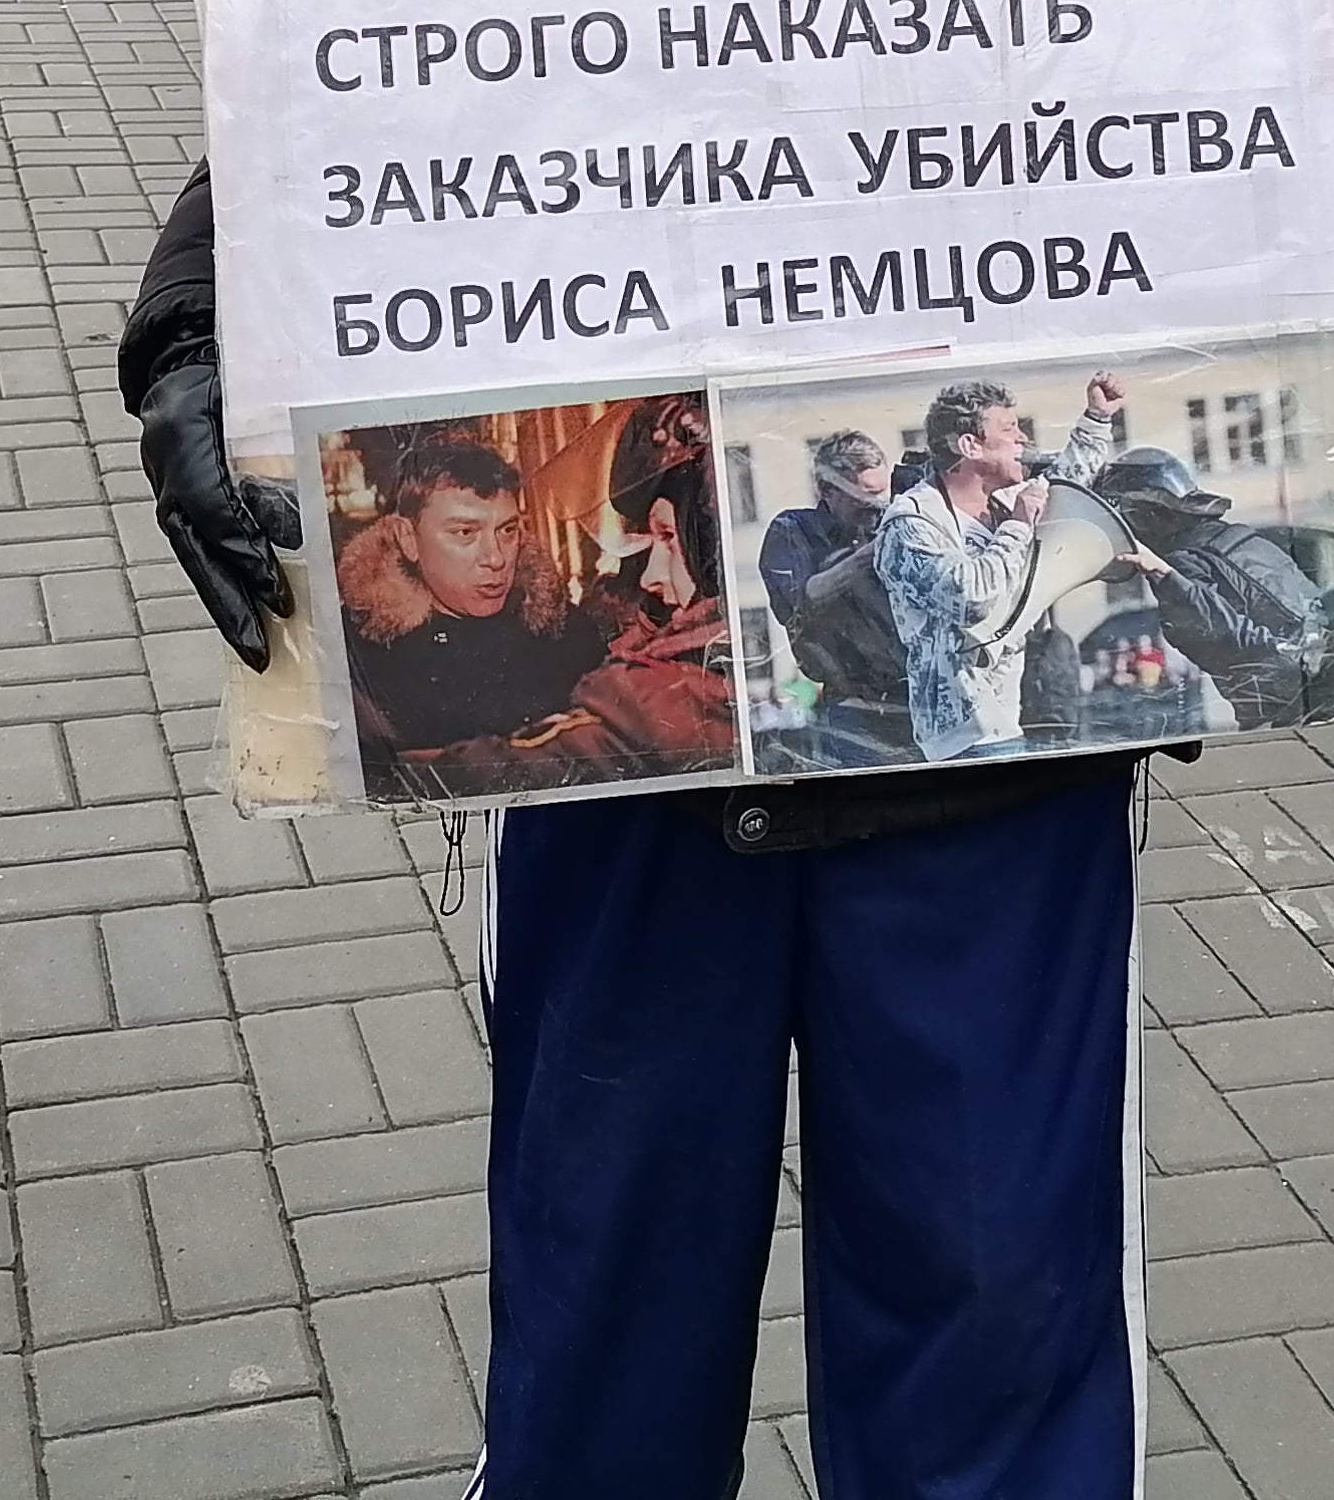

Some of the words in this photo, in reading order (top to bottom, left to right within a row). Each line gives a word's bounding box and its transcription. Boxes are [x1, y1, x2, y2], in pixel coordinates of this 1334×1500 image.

[315, 11, 628, 92] СТРОГО
[323, 136, 814, 229] ЗАКАЗЧИКА
[847, 100, 1296, 194] УБИЙСТВА
[333, 270, 666, 357] БОРИСА
[721, 231, 1153, 327] НЕМЦОВА
